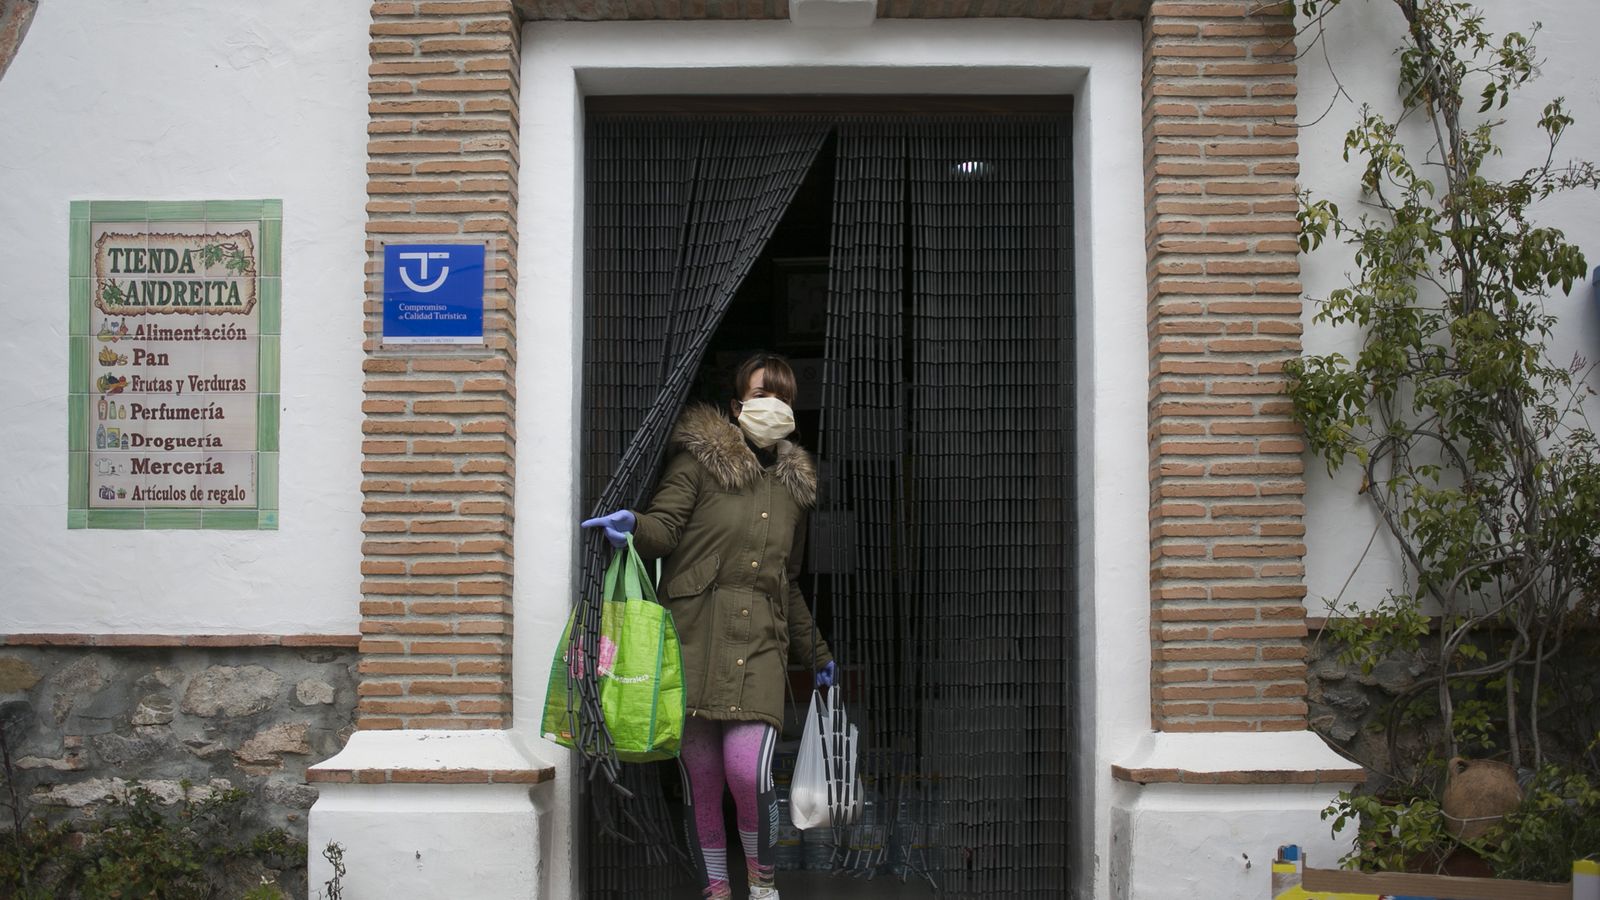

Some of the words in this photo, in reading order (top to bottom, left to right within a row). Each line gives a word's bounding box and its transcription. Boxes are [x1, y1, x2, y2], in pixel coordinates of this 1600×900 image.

[108, 247, 196, 274] TIENDA
[123, 280, 243, 307] ANDREITA
[398, 303, 447, 312] Compromiso
[404, 312, 433, 320] Calidad
[132, 322, 247, 342] Alimentación
[132, 348, 170, 367] Pan
[131, 374, 173, 393] Frutas
[175, 379, 185, 397] y
[187, 374, 247, 392] Verduras
[130, 401, 225, 421] Perfumería
[130, 432, 223, 452] Droguería
[130, 456, 225, 476] Mercería
[131, 484, 187, 502] Artículos
[189, 484, 204, 502] de
[207, 484, 246, 505] regalo
